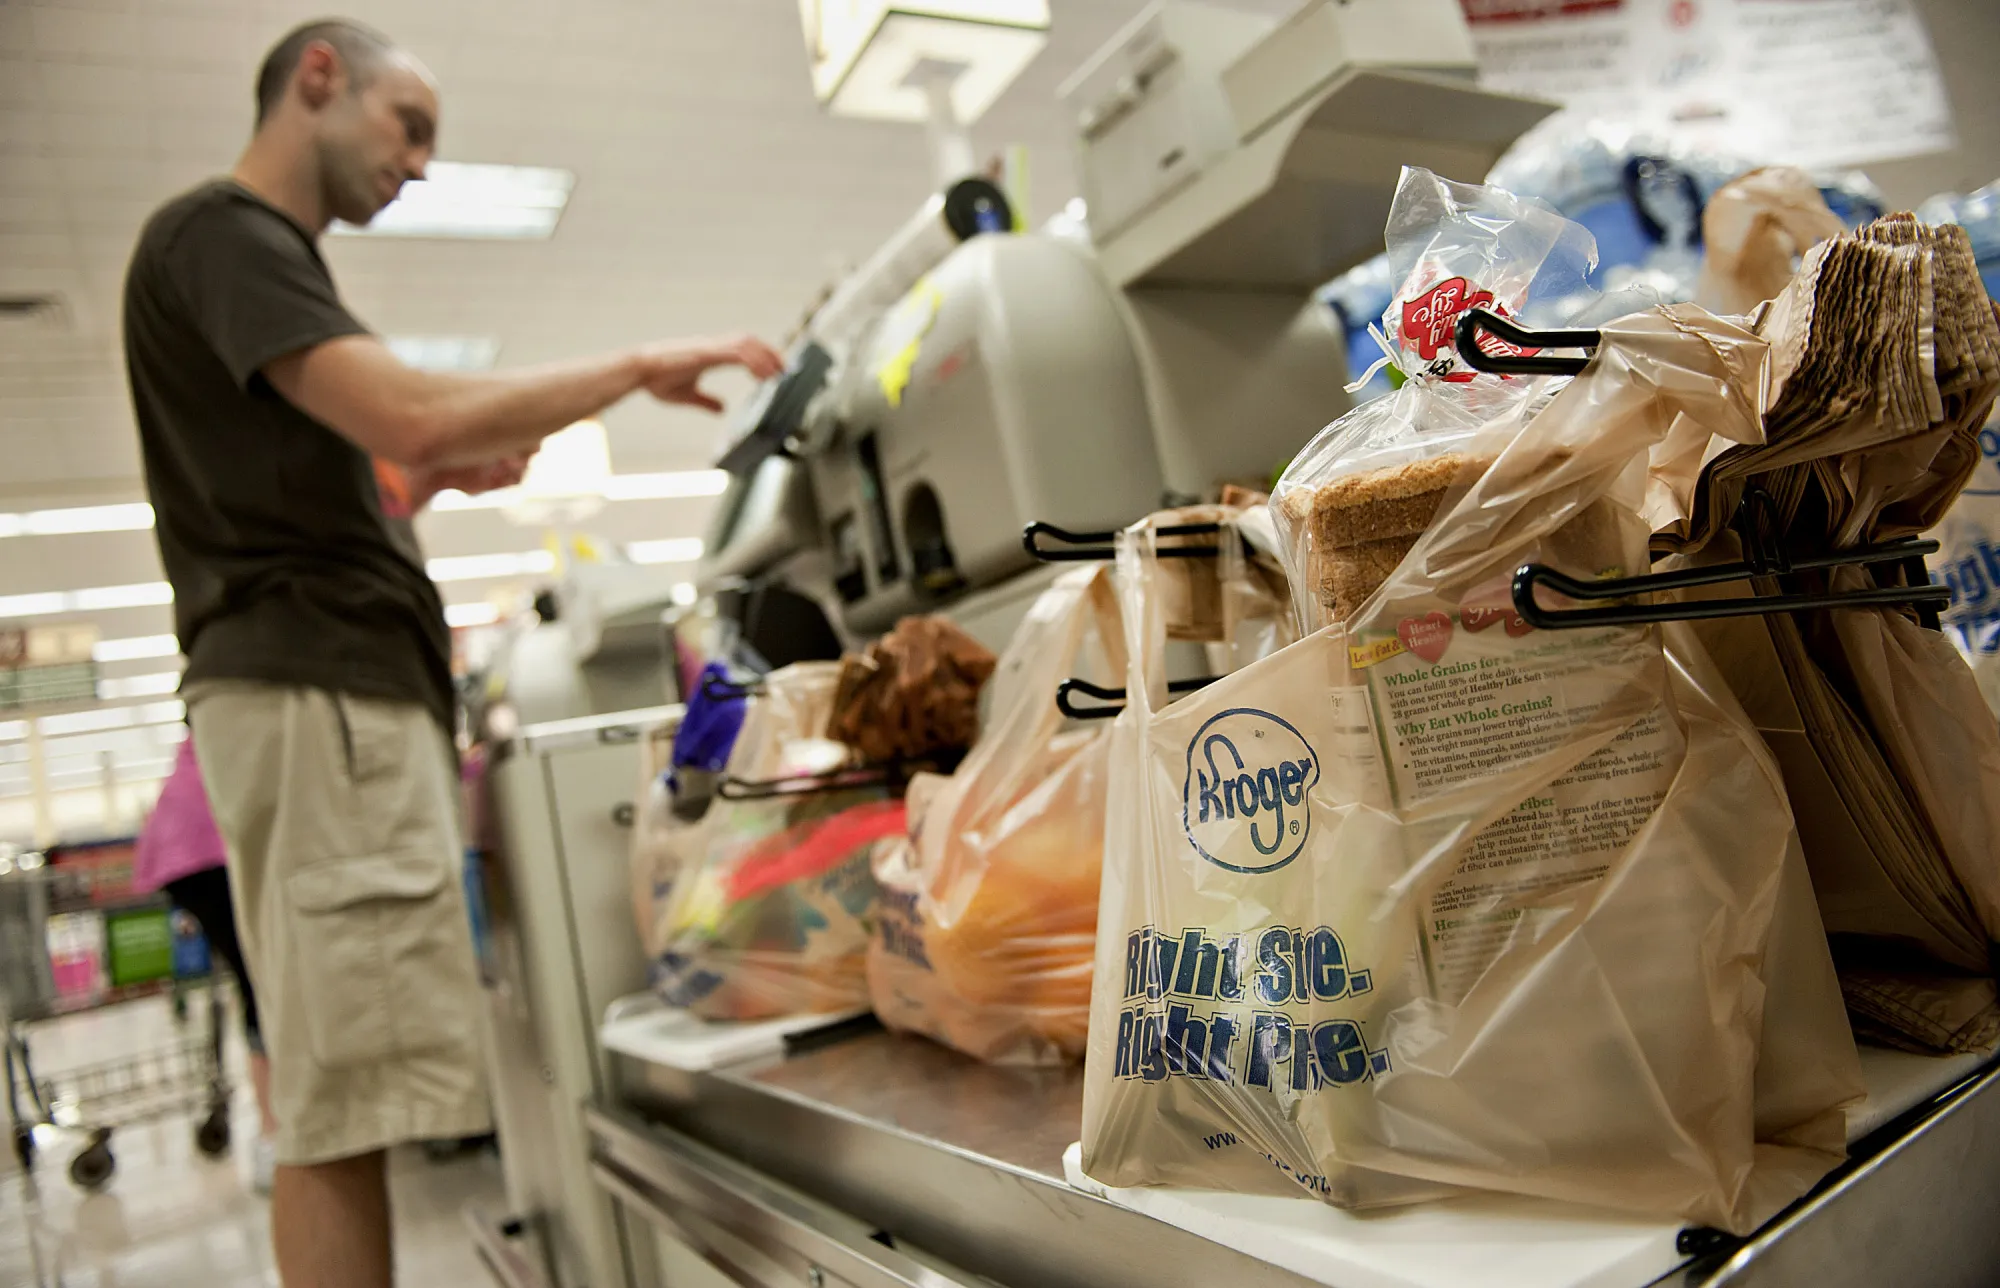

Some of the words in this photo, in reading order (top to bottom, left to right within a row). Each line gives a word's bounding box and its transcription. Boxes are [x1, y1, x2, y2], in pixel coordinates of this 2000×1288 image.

[1412, 288, 1458, 328] Life
[1410, 619, 1440, 635] Heart
[1376, 643, 1390, 657] Fat
[1392, 639, 1400, 651] &
[1384, 669, 1428, 687] Whole
[1431, 661, 1477, 678] Grains
[1480, 656, 1500, 669] for
[1388, 690, 1405, 699] You
[1408, 687, 1421, 695] can
[1424, 680, 1446, 692] fulfill
[1448, 677, 1466, 687] 58%
[1469, 673, 1477, 682] of
[1480, 672, 1493, 680] the
[1496, 667, 1515, 678] daily
[1390, 698, 1408, 709] with
[1410, 697, 1425, 705] one
[1427, 690, 1458, 700] serving
[1460, 686, 1468, 695] of
[1470, 680, 1504, 693] Healthy
[1505, 677, 1522, 686] Life
[1524, 672, 1541, 682] Soft
[1392, 710, 1402, 719] 28
[1404, 706, 1429, 719] grams
[1431, 702, 1440, 711] of
[1441, 698, 1466, 709] whole
[1467, 694, 1496, 706] grains.
[1394, 722, 1426, 736] Why
[1428, 717, 1451, 730] Eat
[1452, 707, 1498, 725] Whole
[1501, 695, 1553, 716] Grains?
[1407, 734, 1435, 746] Whole
[1436, 729, 1462, 743] grains
[1464, 726, 1481, 736] may
[1482, 721, 1507, 732] lower
[1410, 746, 1429, 756] with
[1431, 741, 1458, 753] weight
[1460, 731, 1514, 747] management
[1516, 726, 1532, 736] and
[1412, 759, 1428, 769] The
[1430, 752, 1468, 765] vitamins,
[1469, 744, 1508, 758] minerals,
[1415, 768, 1441, 780] grains
[1443, 764, 1453, 773] all
[1454, 759, 1476, 770] work
[1477, 754, 1512, 767] together
[1514, 749, 1532, 760] with
[1574, 759, 1597, 772] other
[1599, 756, 1626, 768] foods,
[1627, 751, 1652, 763] whole
[1417, 778, 1433, 788] risk
[1434, 776, 1444, 784] of
[1445, 773, 1467, 783] some
[1551, 771, 1611, 786] ancer-causing
[1612, 767, 1629, 777] free
[1631, 761, 1664, 774] radicals.
[1197, 734, 1312, 855] Kroger
[1511, 812, 1536, 824] Bread
[1538, 810, 1553, 819] has
[1563, 805, 1589, 818] grams
[1591, 801, 1600, 810] of
[1602, 798, 1622, 810] fiber
[1624, 797, 1634, 805] in
[1635, 795, 1651, 804] two
[1476, 824, 1530, 842] ecommended
[1531, 819, 1552, 830] daily
[1583, 814, 1591, 823] A
[1592, 812, 1608, 821] diet
[1610, 804, 1652, 818] including
[1477, 840, 1495, 852] help
[1500, 836, 1527, 847] reduce
[1531, 832, 1544, 841] the
[1569, 826, 1578, 835] of
[1581, 819, 1629, 834] developing
[1457, 865, 1466, 875] of
[1467, 861, 1486, 872] fiber
[1488, 860, 1503, 868] can
[1506, 856, 1522, 866] also
[1600, 841, 1610, 852] by
[1469, 852, 1485, 862] well
[1487, 851, 1496, 859] as
[1498, 842, 1550, 857] maintaining
[1591, 830, 1620, 842] health.
[1123, 924, 1247, 1003] Right
[1112, 1001, 1240, 1085] Right
